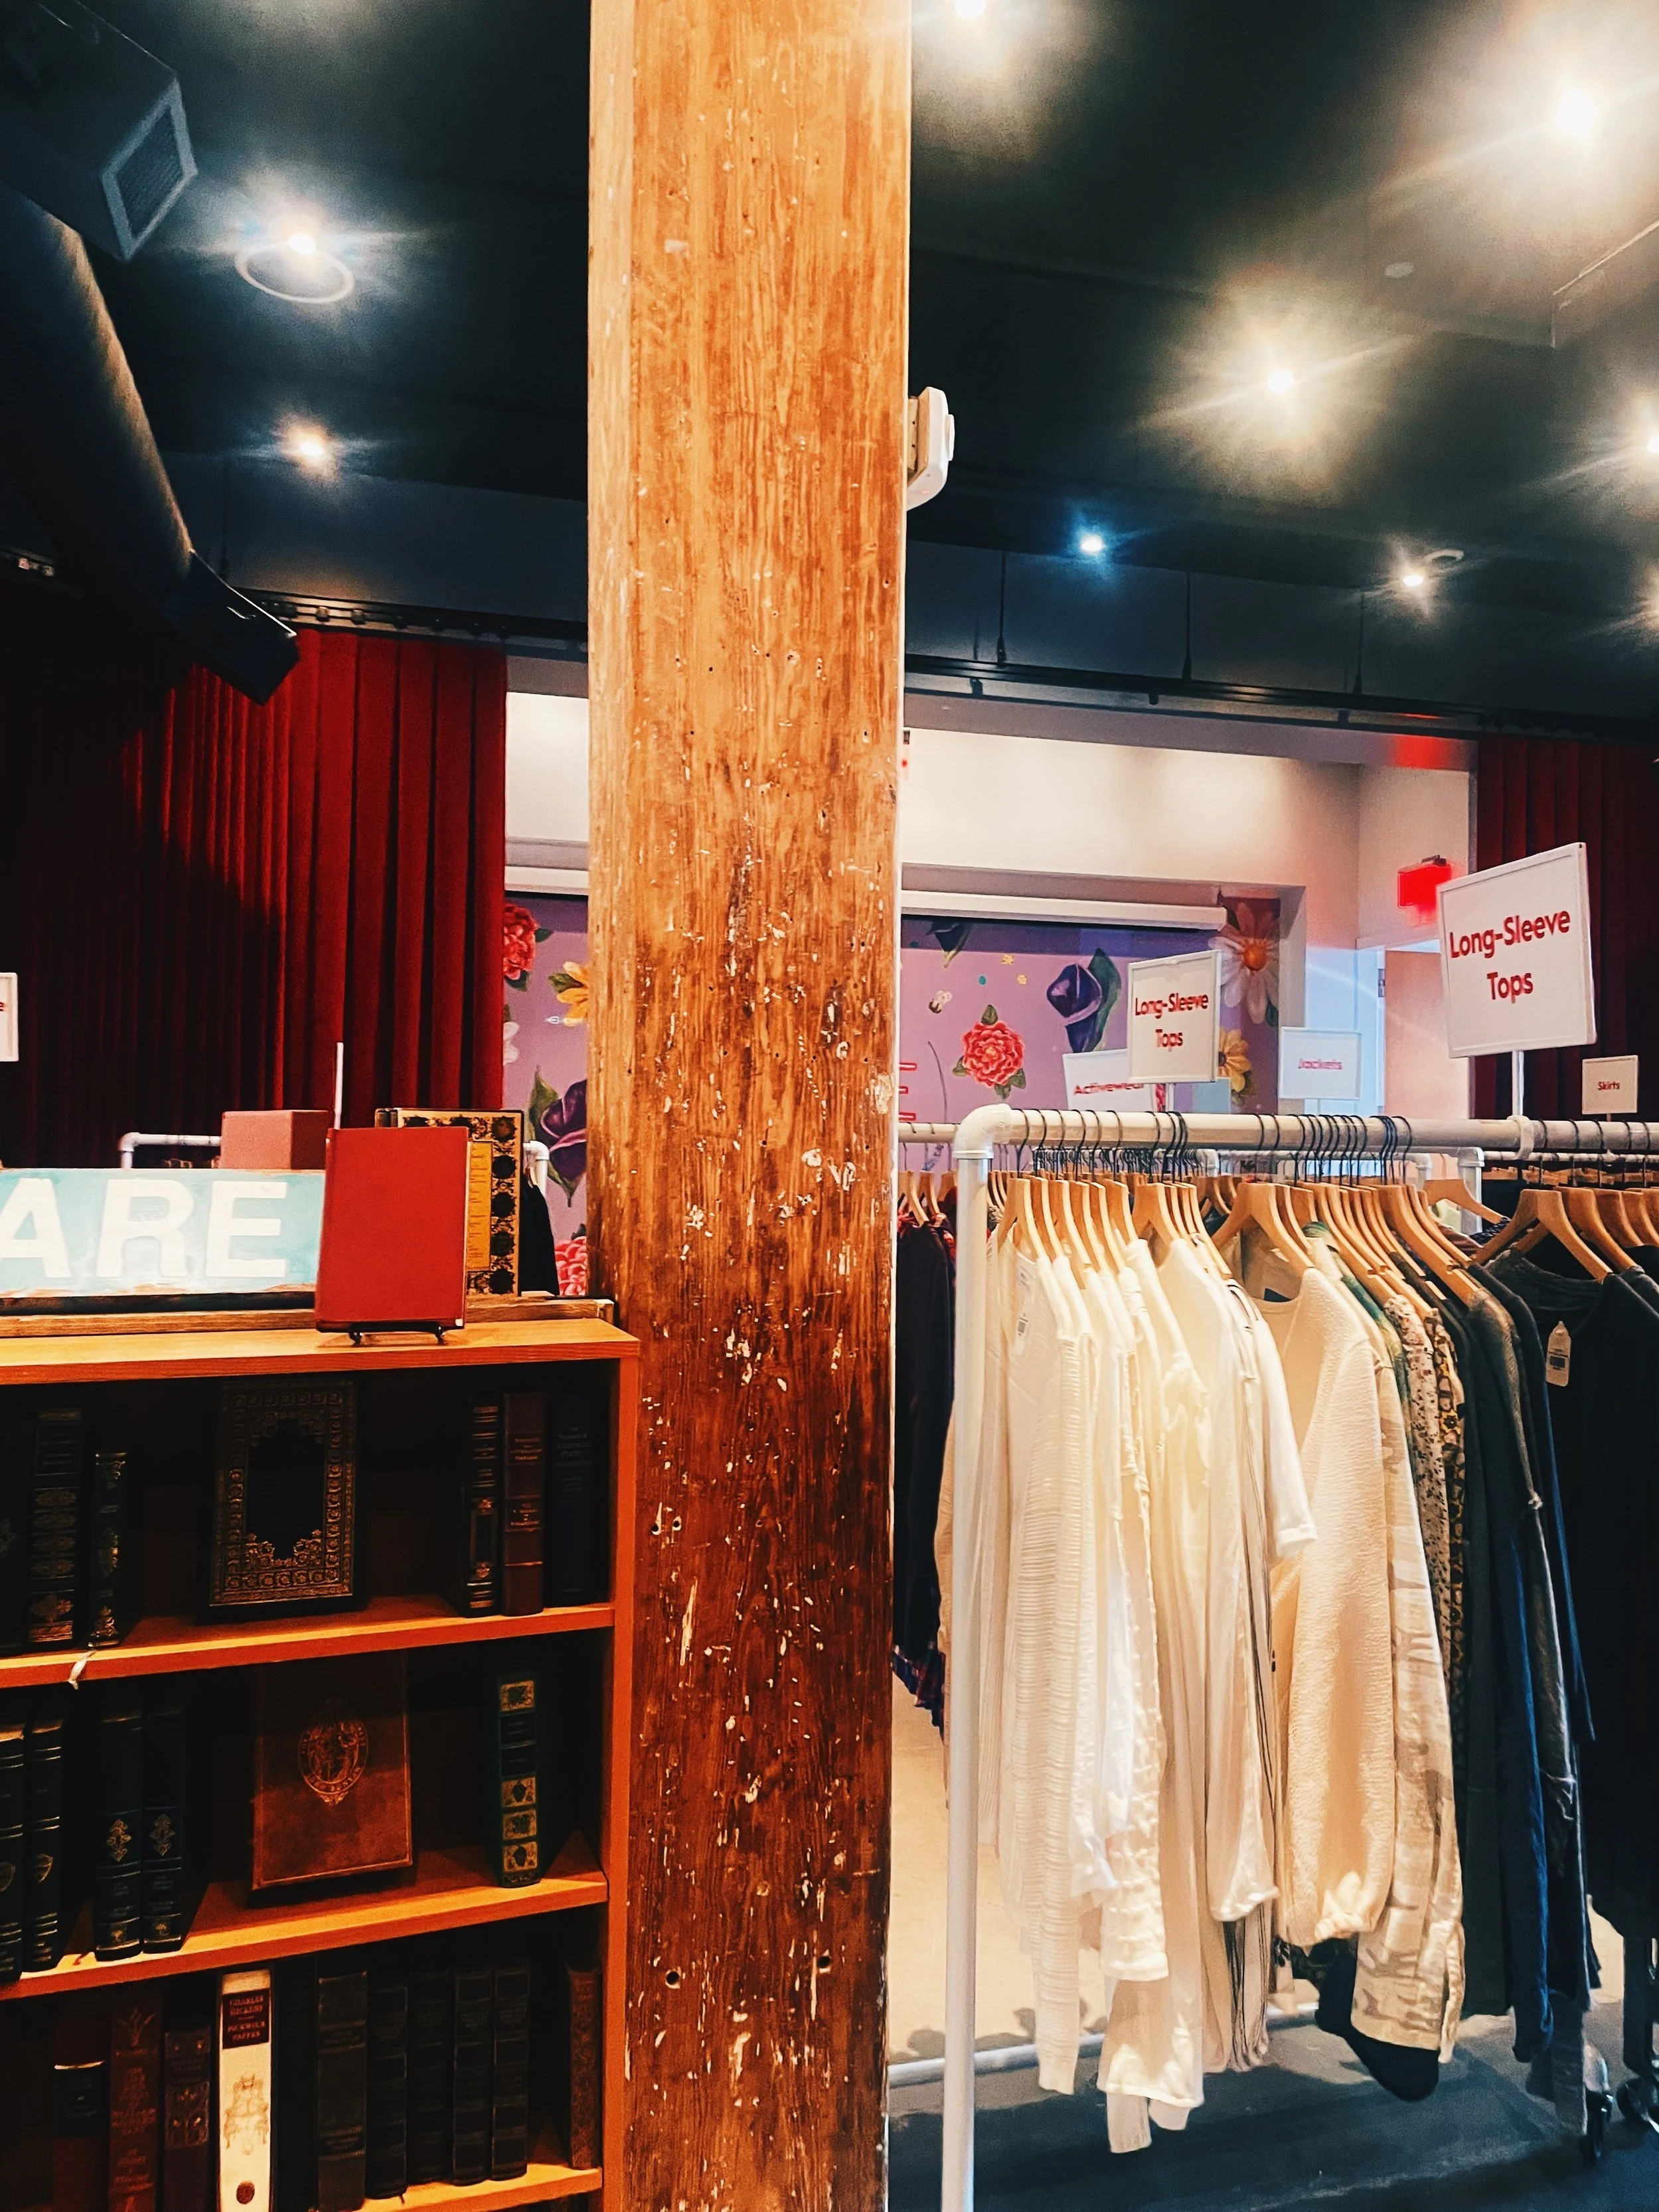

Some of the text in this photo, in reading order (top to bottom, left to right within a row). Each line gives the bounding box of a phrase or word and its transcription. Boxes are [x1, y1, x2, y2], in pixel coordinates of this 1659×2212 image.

[1449, 910, 1571, 959] Long-Sleeve
[1486, 972, 1534, 1004] Tops
[1135, 992, 1209, 1019] Long-Sleeve
[1155, 1029, 1184, 1052] Tops
[0, 1178, 287, 1278] ARE
